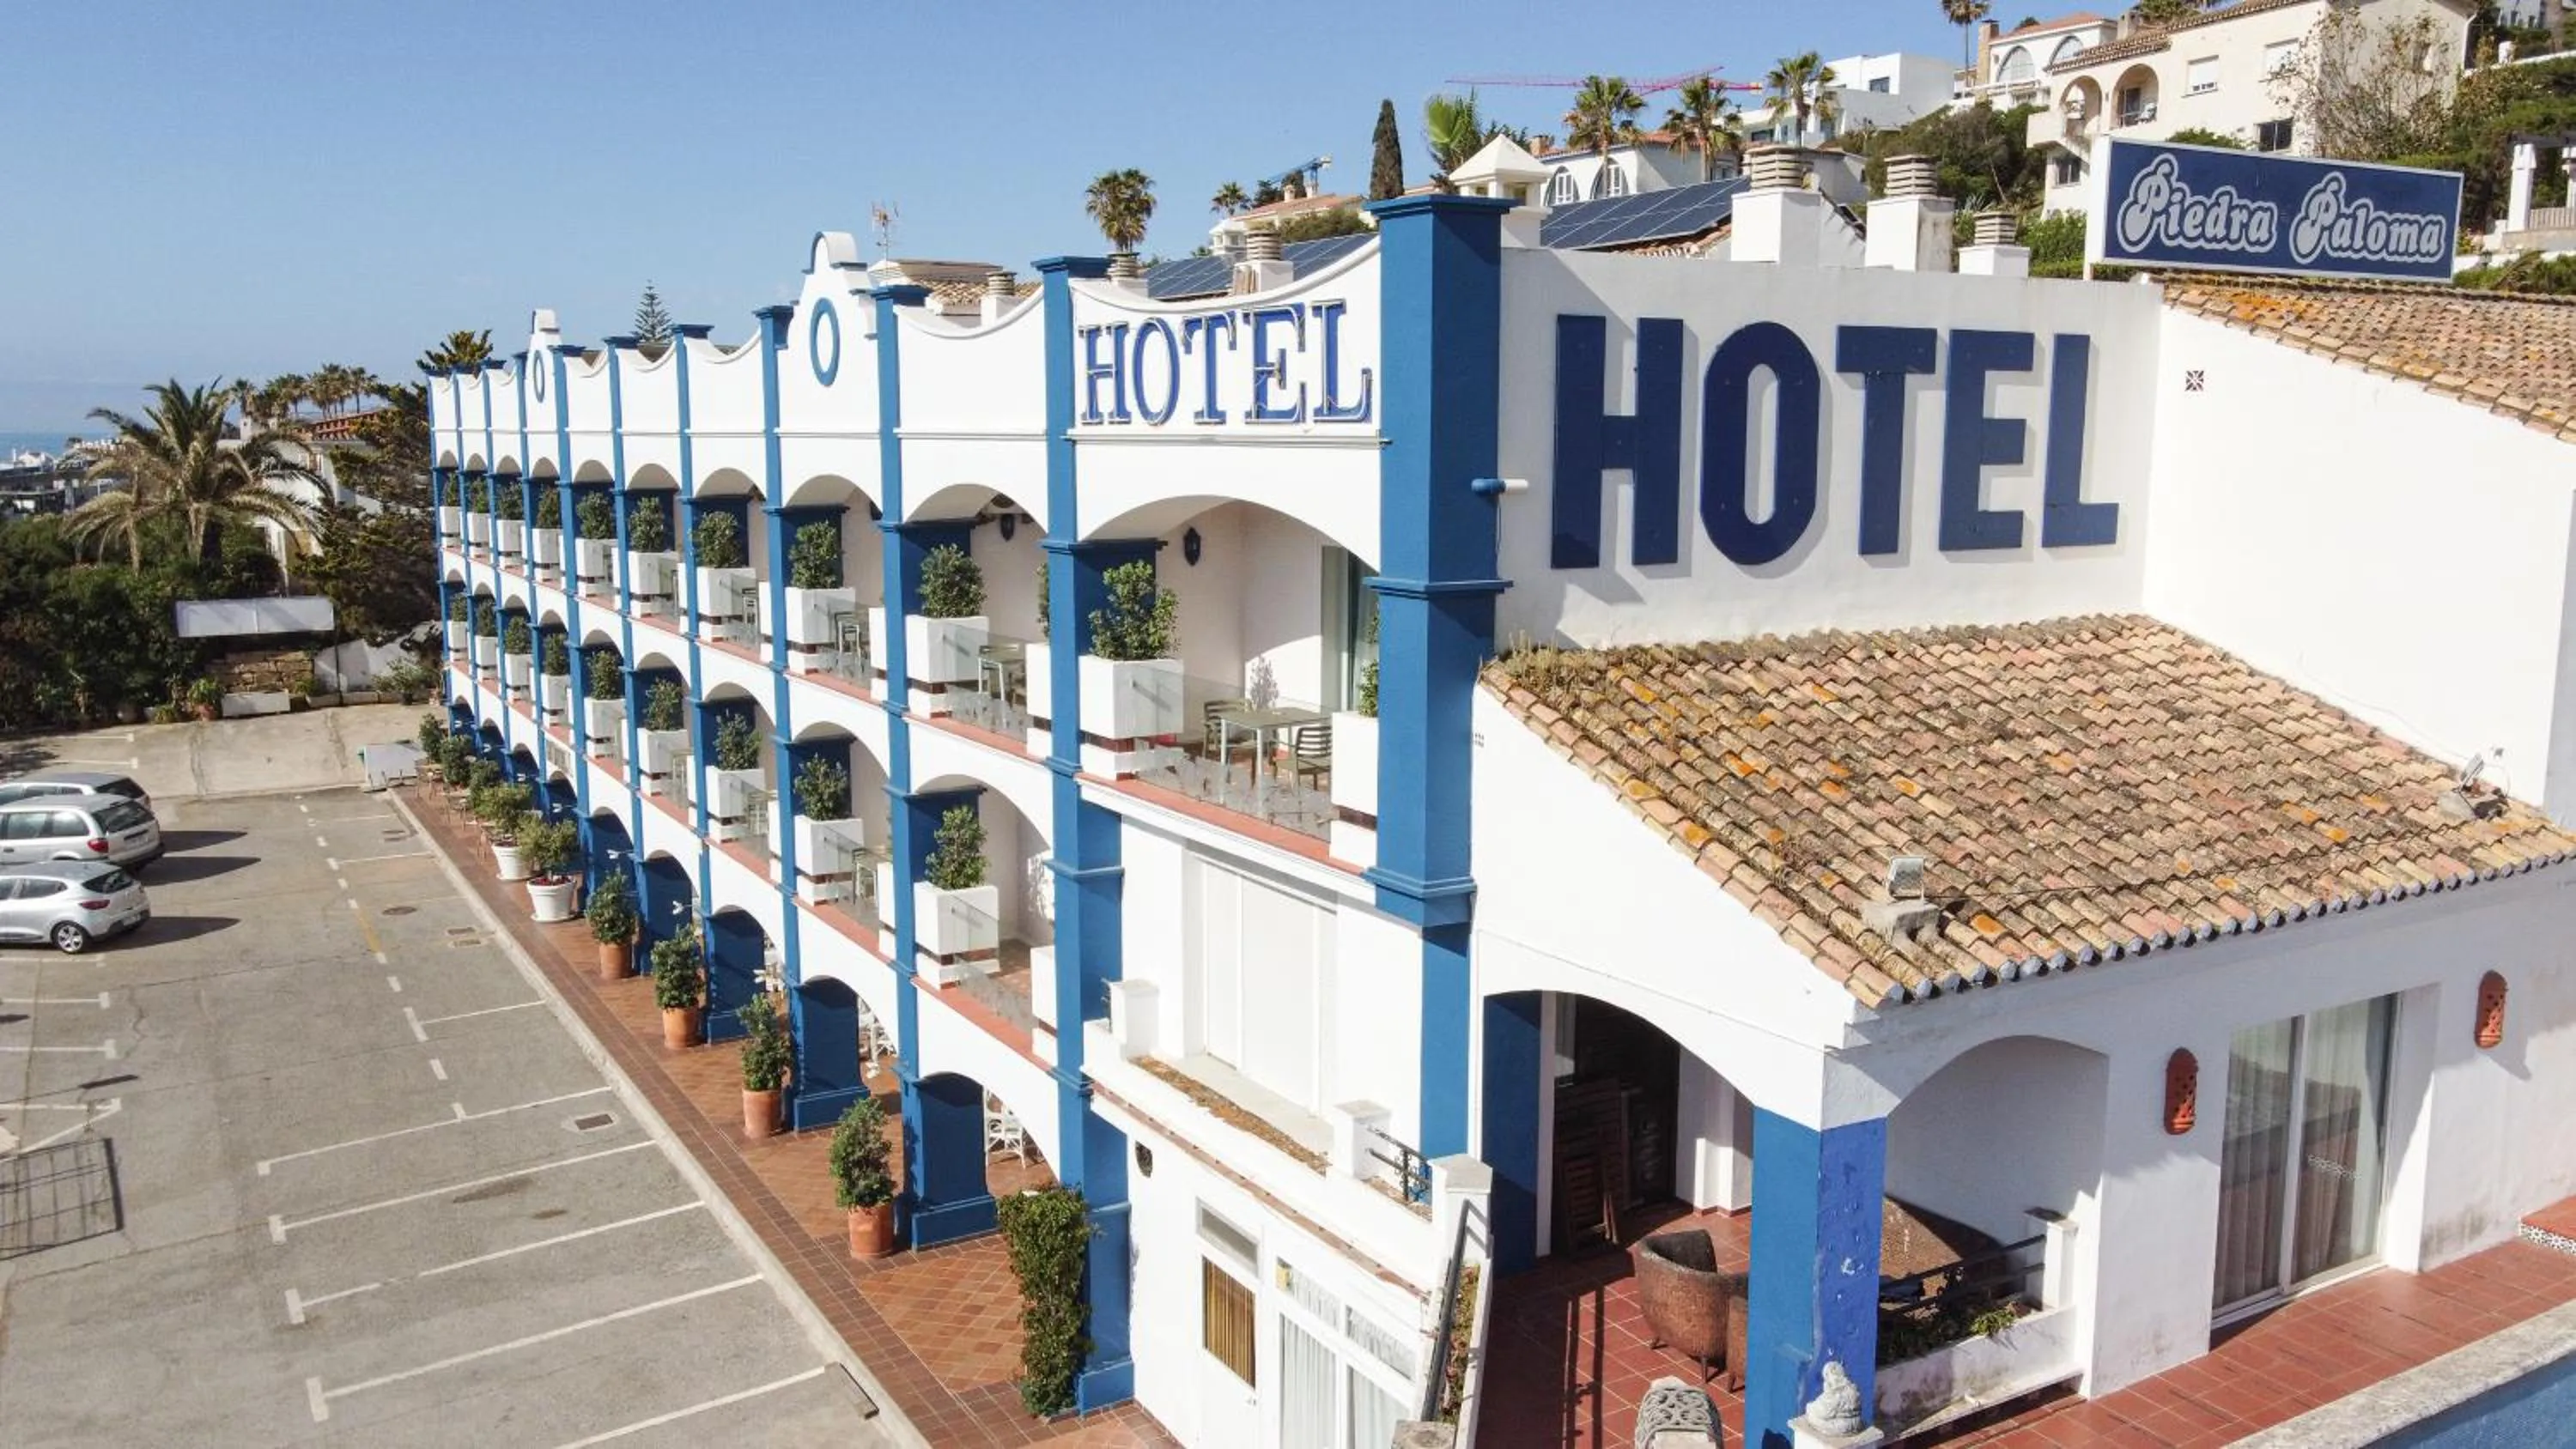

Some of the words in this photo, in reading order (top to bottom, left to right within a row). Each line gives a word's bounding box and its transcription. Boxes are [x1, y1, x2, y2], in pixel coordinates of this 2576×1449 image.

[2117, 153, 2278, 252] Piedra
[2290, 172, 2445, 264] Paloma
[1078, 298, 1373, 426] HOTEL
[1551, 315, 2119, 569] HOTEL
